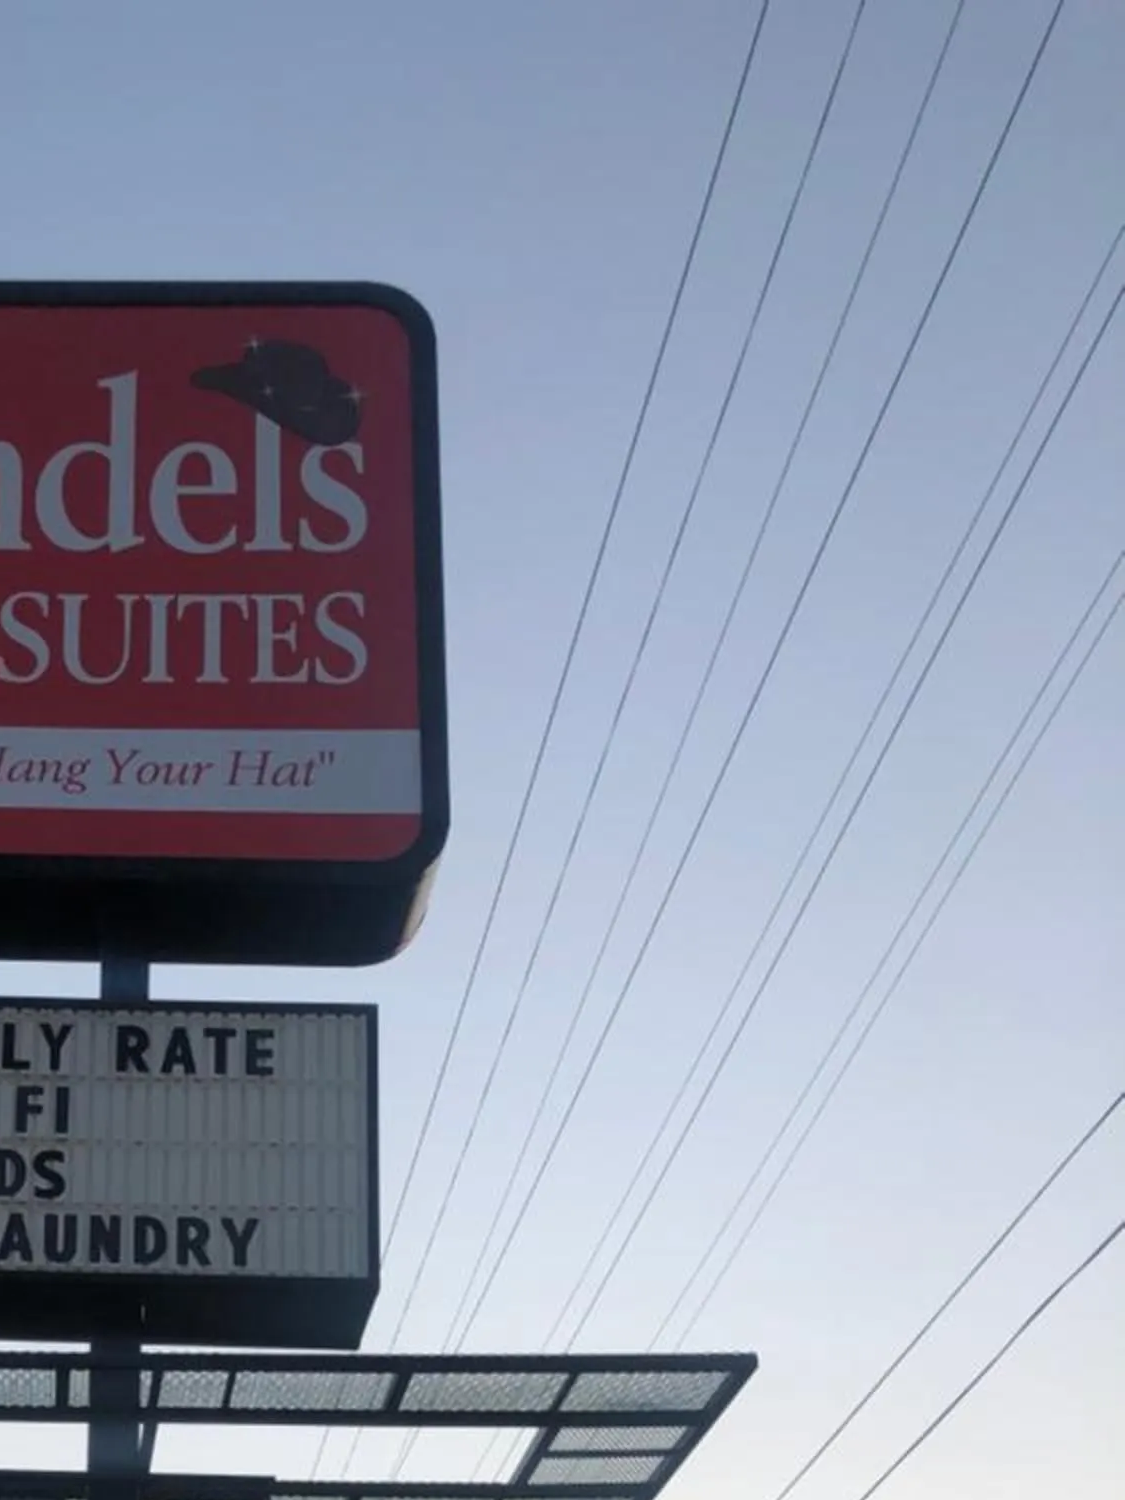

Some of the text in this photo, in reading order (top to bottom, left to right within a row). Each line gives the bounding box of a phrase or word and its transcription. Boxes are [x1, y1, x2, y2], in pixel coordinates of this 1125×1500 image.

[106, 748, 215, 788] Your
[224, 750, 336, 789] Hat"
[115, 1024, 276, 1076] RATE
